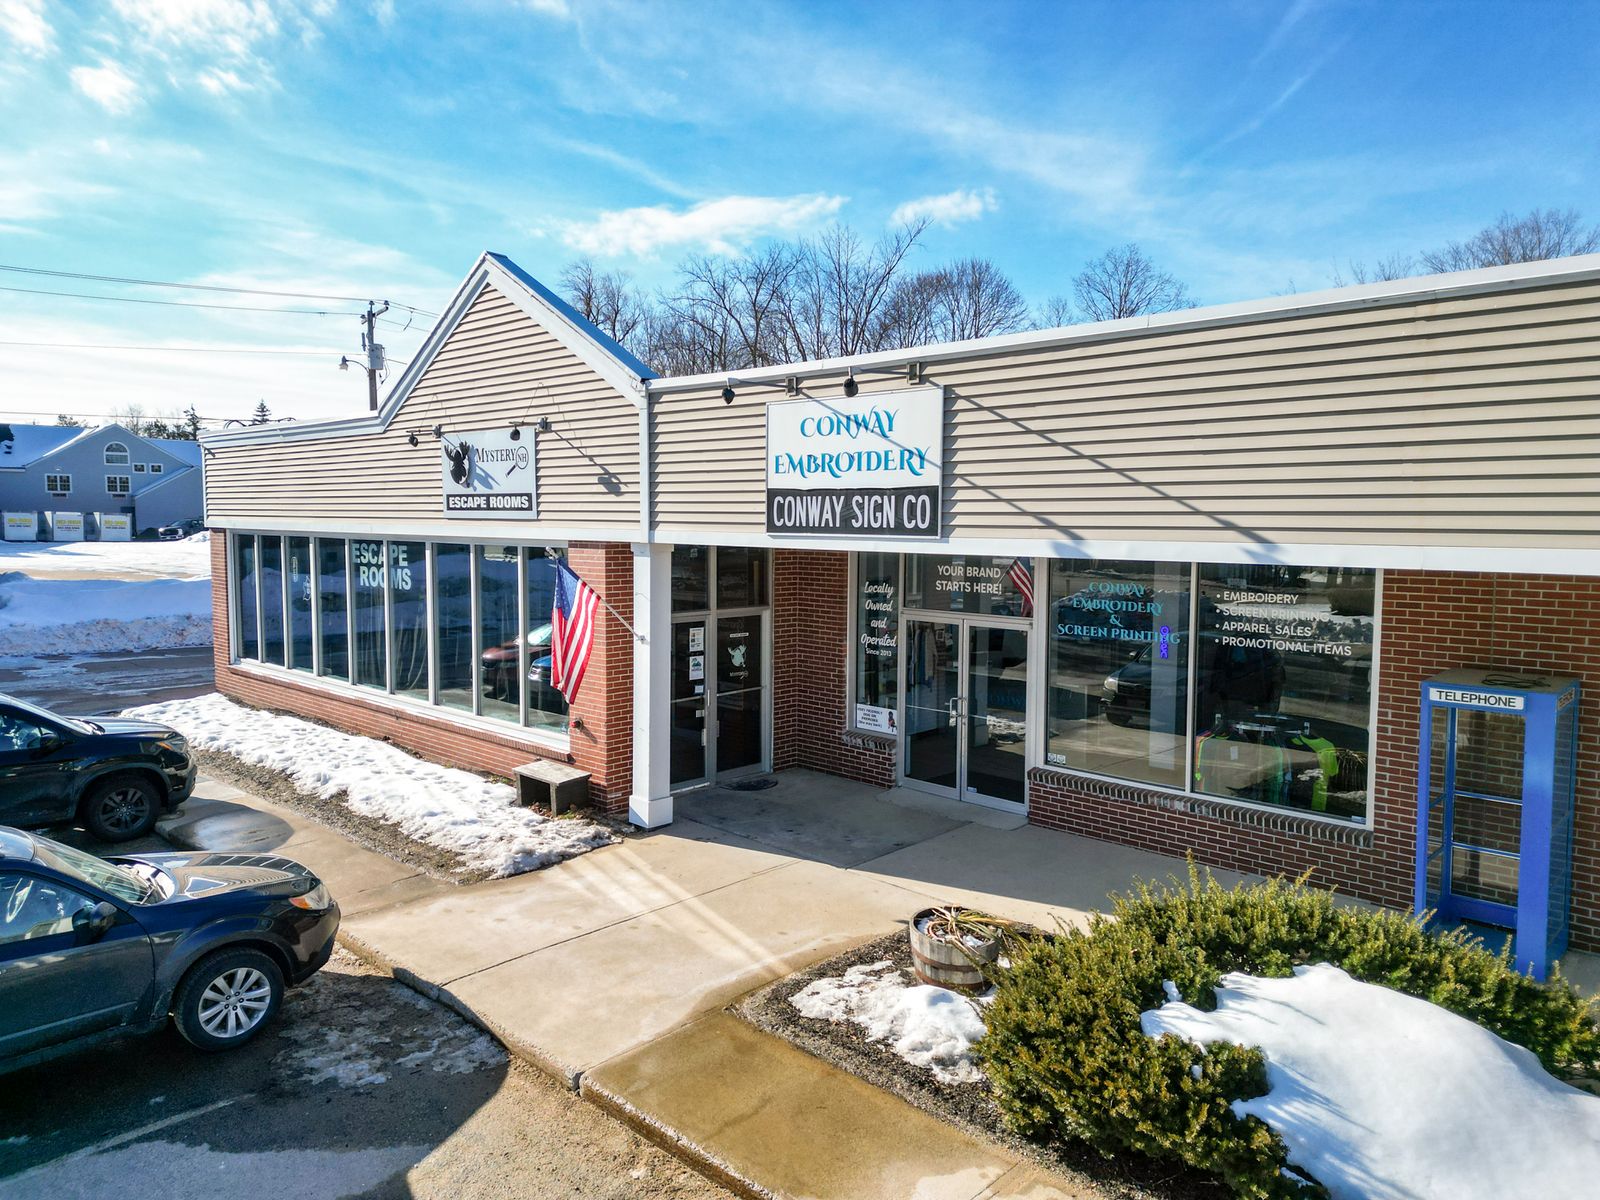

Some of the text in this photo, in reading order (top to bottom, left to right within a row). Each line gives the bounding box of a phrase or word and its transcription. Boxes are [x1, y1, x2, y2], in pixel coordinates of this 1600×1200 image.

[800, 405, 899, 439] CONWAY
[774, 446, 931, 479] EMBROIDERY
[449, 495, 529, 508] ESCAPE ROOMS
[773, 494, 931, 529] CONWAY SIGN CO
[360, 565, 412, 590] ROOMS
[937, 565, 1001, 578] YOUR BRAND
[864, 581, 894, 599] Locally
[935, 580, 1002, 595] STARTS HERE!
[1089, 581, 1146, 597] CONWAY
[865, 599, 893, 612] Owned
[1223, 591, 1299, 604] EMBROIDERY
[1072, 597, 1164, 616] EMBROIDERY
[1222, 607, 1331, 622] SCREEN PRINTING
[870, 617, 887, 629] and
[1109, 614, 1124, 627] &
[1057, 623, 1108, 639] SCREEN
[1222, 621, 1312, 637] APPAREL SALES
[860, 633, 897, 648] Operated
[1222, 636, 1352, 656] PROMOTIONAL ITEMS
[866, 647, 880, 656] Since
[1437, 690, 1517, 707] TELEPHONE
